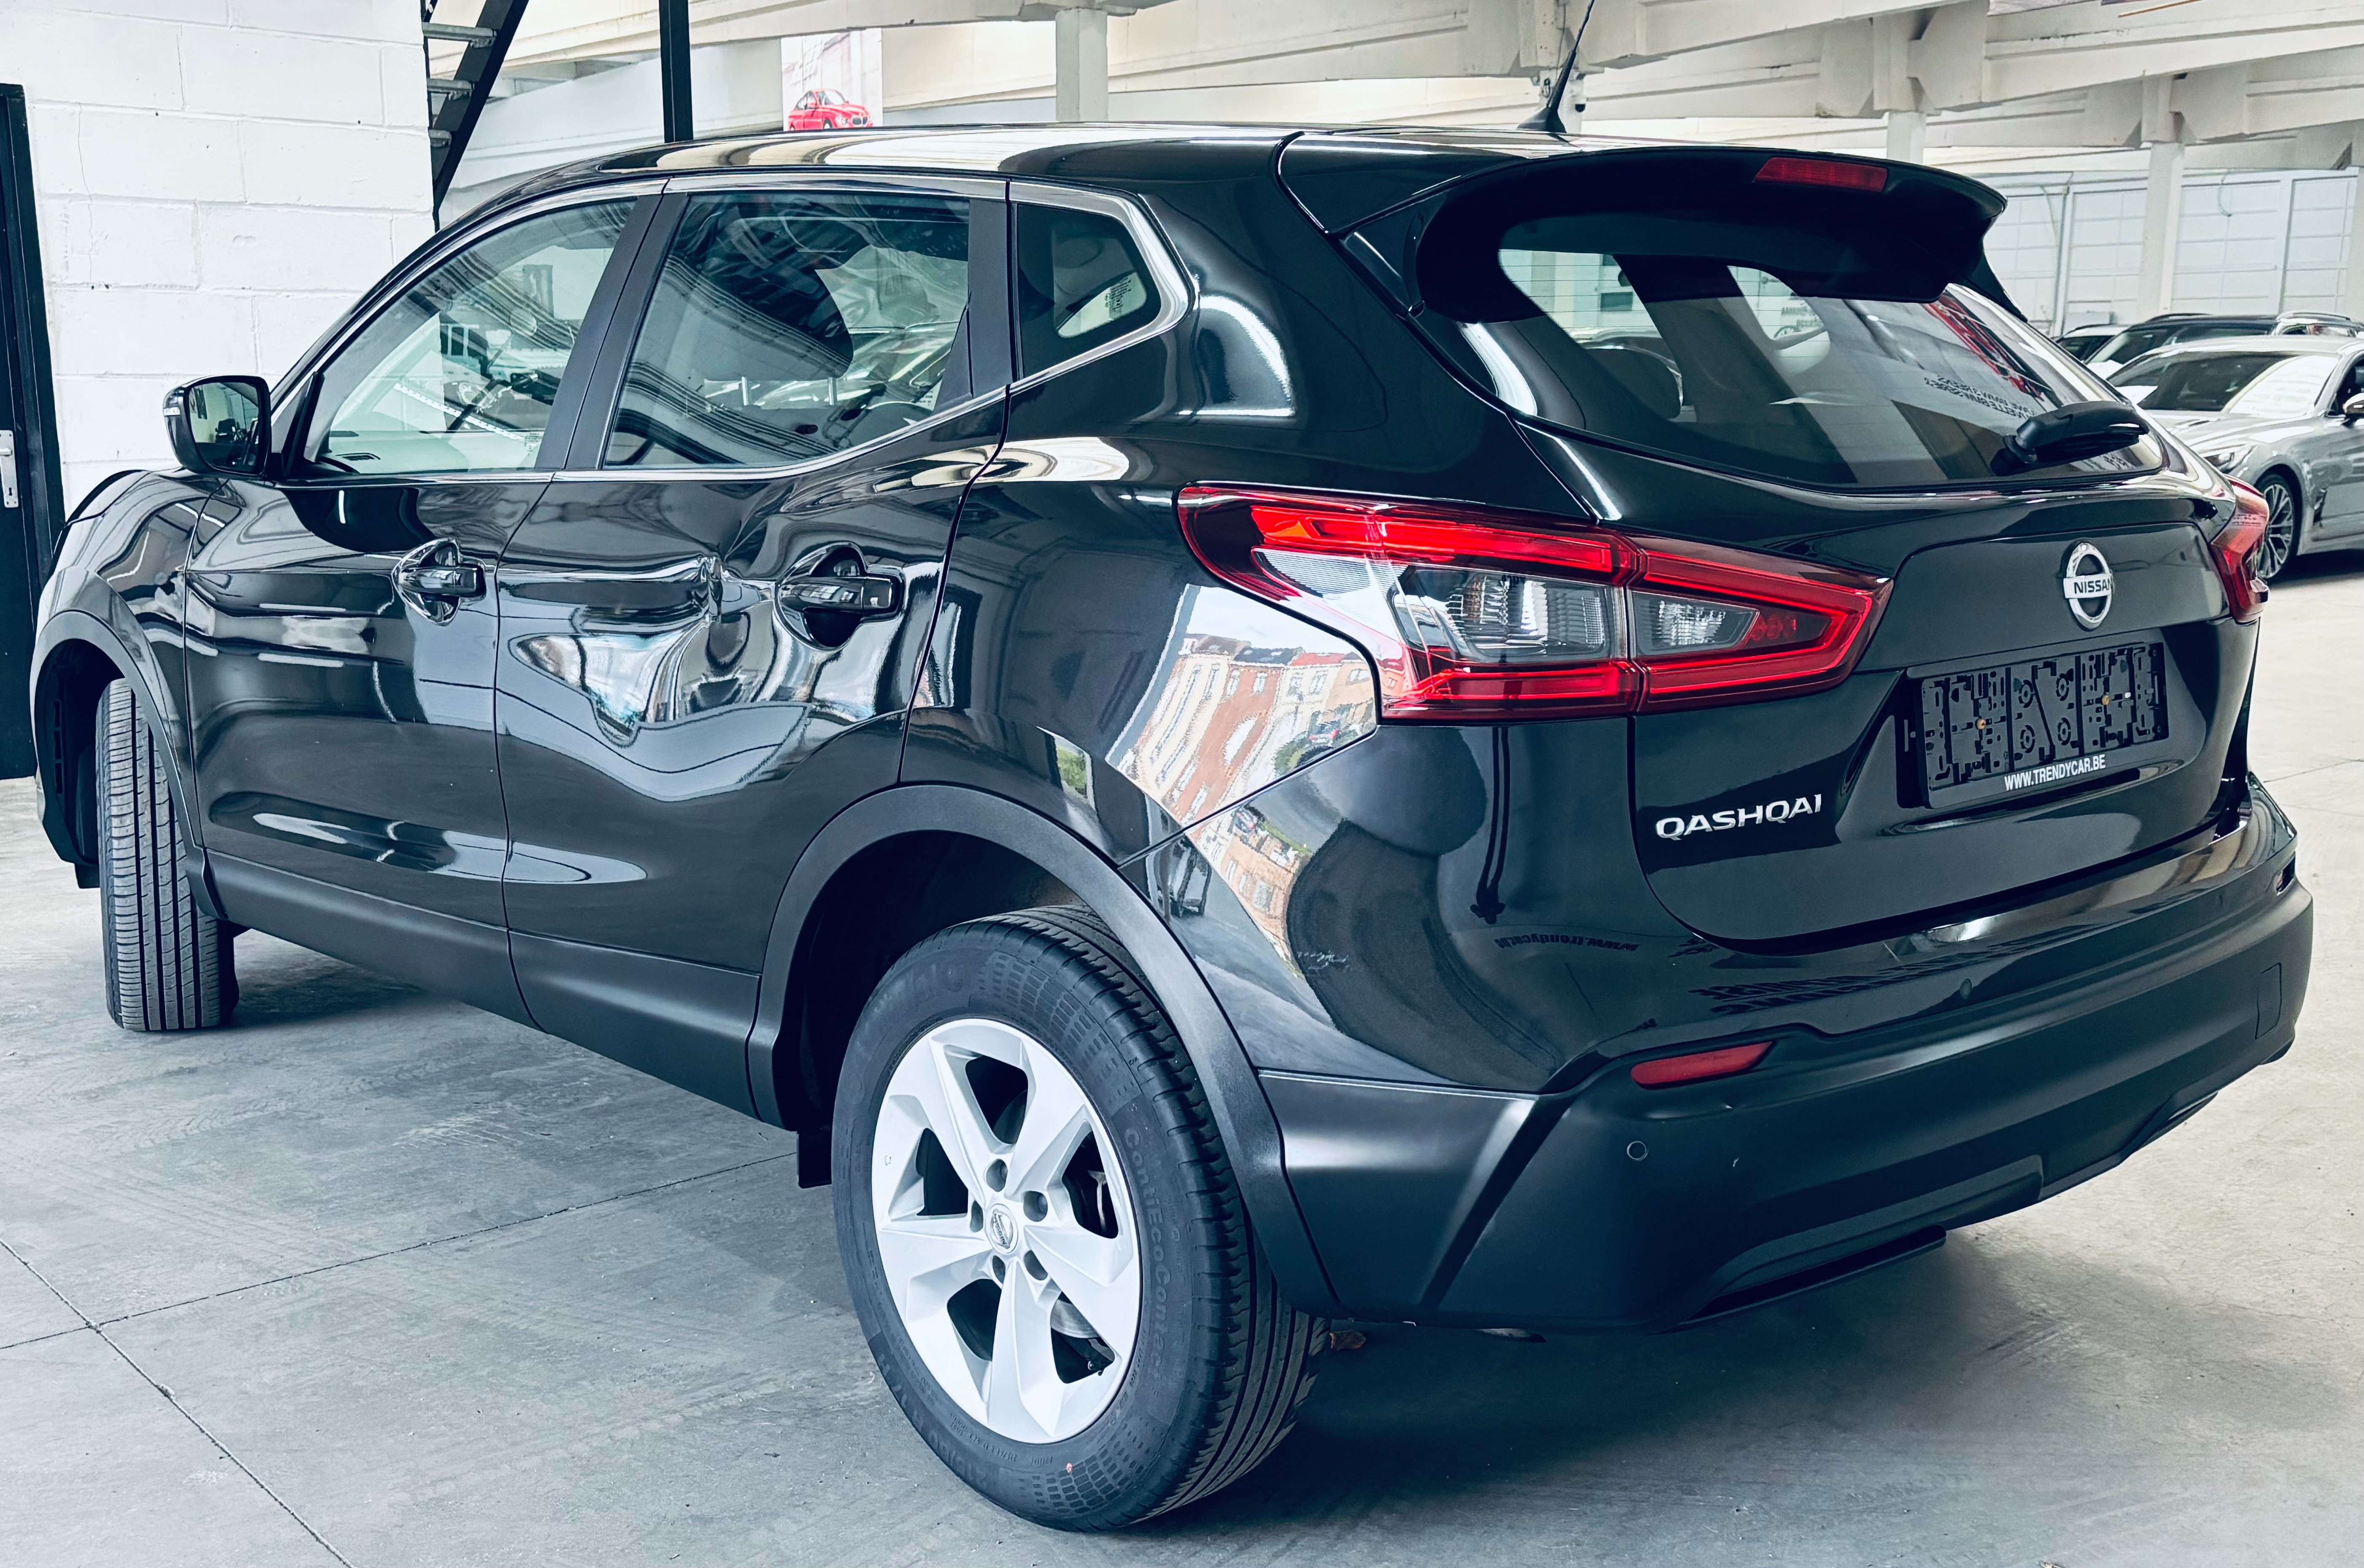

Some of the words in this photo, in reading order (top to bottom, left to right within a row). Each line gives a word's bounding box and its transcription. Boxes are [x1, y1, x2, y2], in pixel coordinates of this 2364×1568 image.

[2074, 576, 2113, 594] NISSAN
[2004, 754, 2106, 791] WWW.TRENDYCAR.BE
[1655, 794, 1822, 841] QASHQAI
